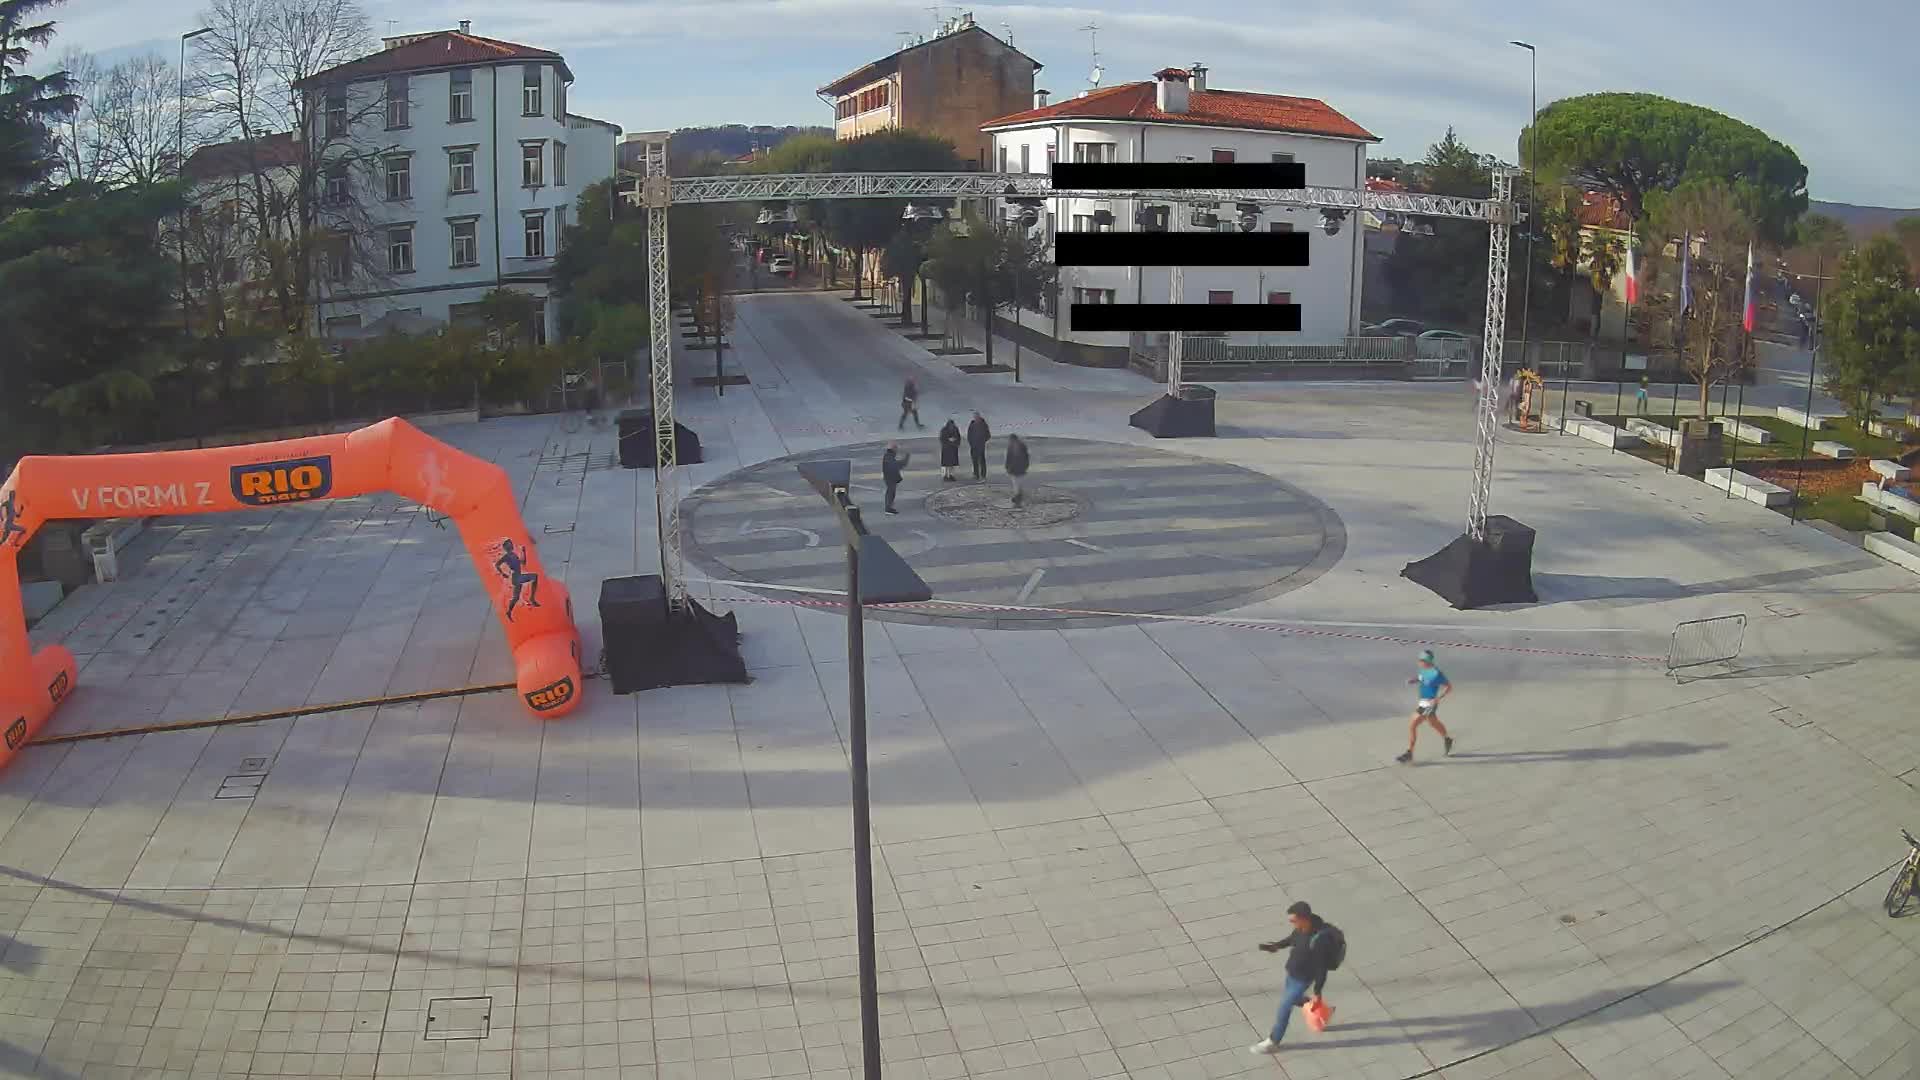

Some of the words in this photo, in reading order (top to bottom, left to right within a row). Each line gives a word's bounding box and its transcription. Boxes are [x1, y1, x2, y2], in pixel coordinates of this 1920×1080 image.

[241, 465, 322, 496] RIO
[71, 487, 90, 511] V
[98, 482, 187, 510] FORMI
[193, 481, 215, 505] Z
[530, 683, 570, 706] RIO
